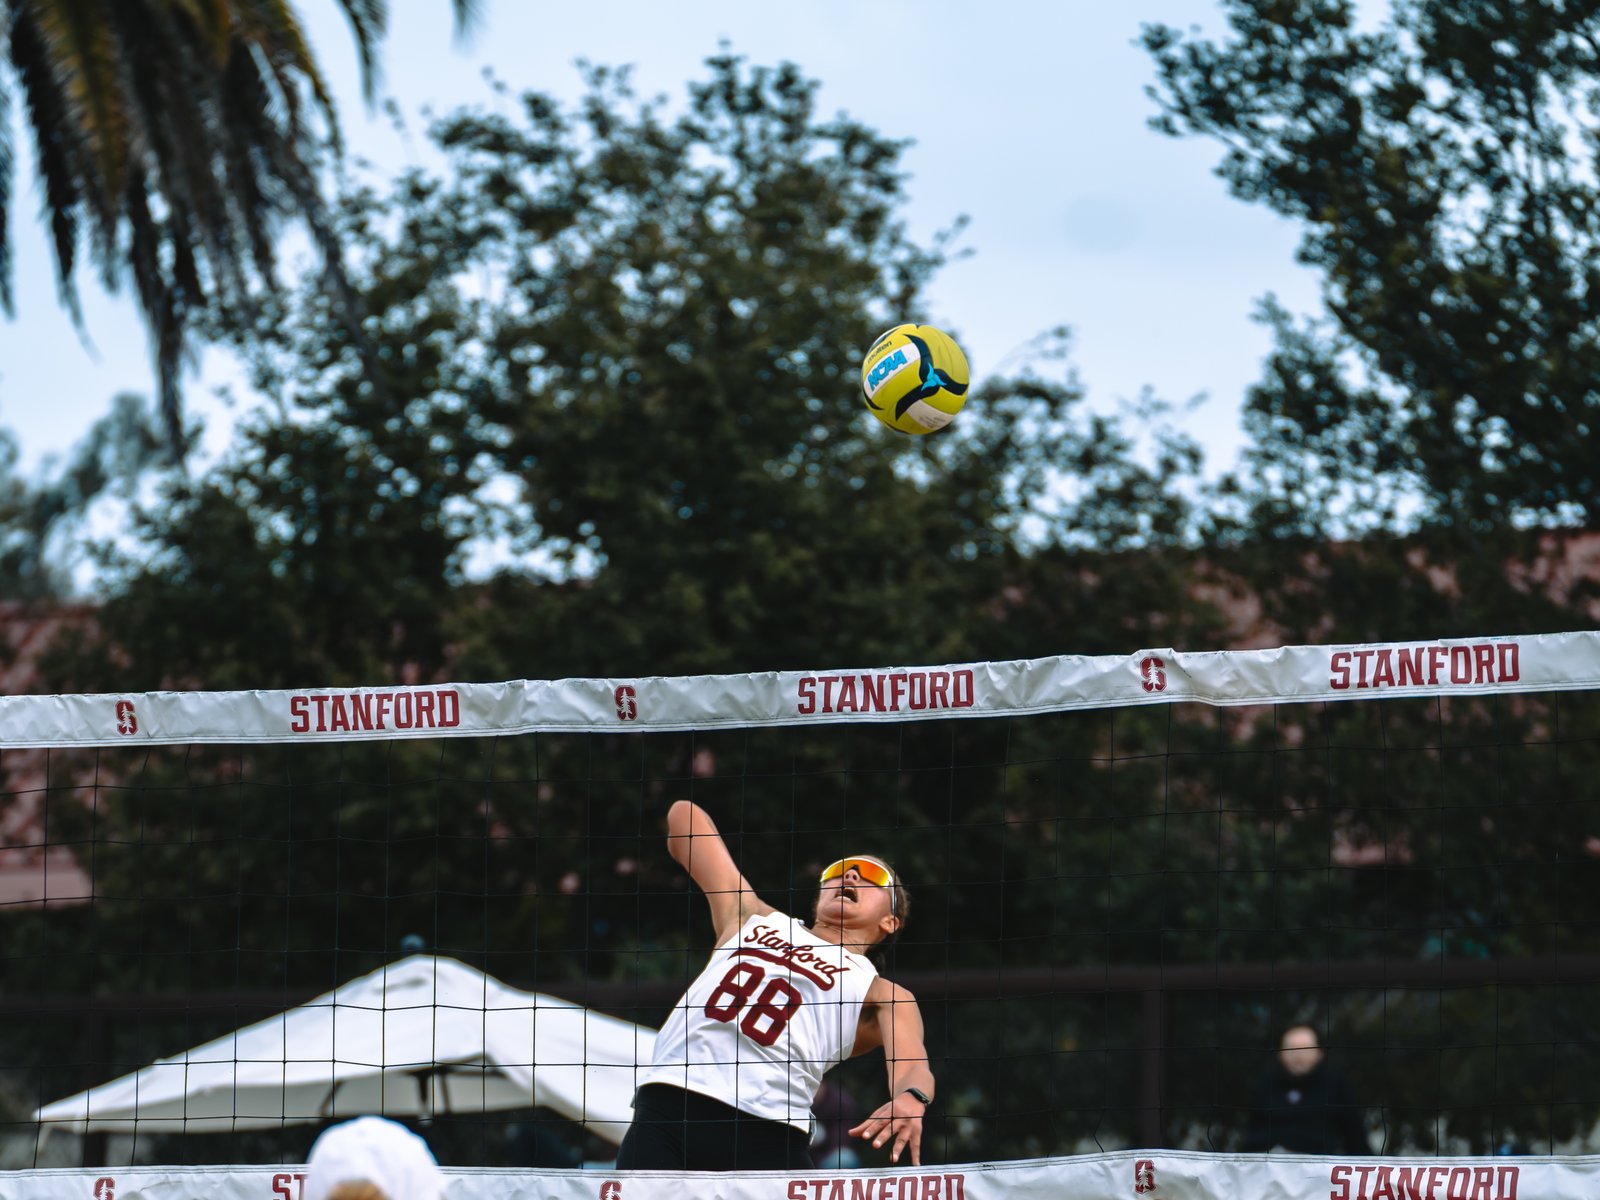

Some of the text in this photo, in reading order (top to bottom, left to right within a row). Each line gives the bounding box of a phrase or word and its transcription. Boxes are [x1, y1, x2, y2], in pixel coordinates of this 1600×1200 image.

[867, 350, 907, 391] NCAA
[1330, 643, 1520, 690] STANFORD
[290, 690, 460, 733] STANFORD
[799, 670, 974, 715] STANFORD
[744, 925, 850, 978] Stanford
[704, 962, 803, 1047] 88
